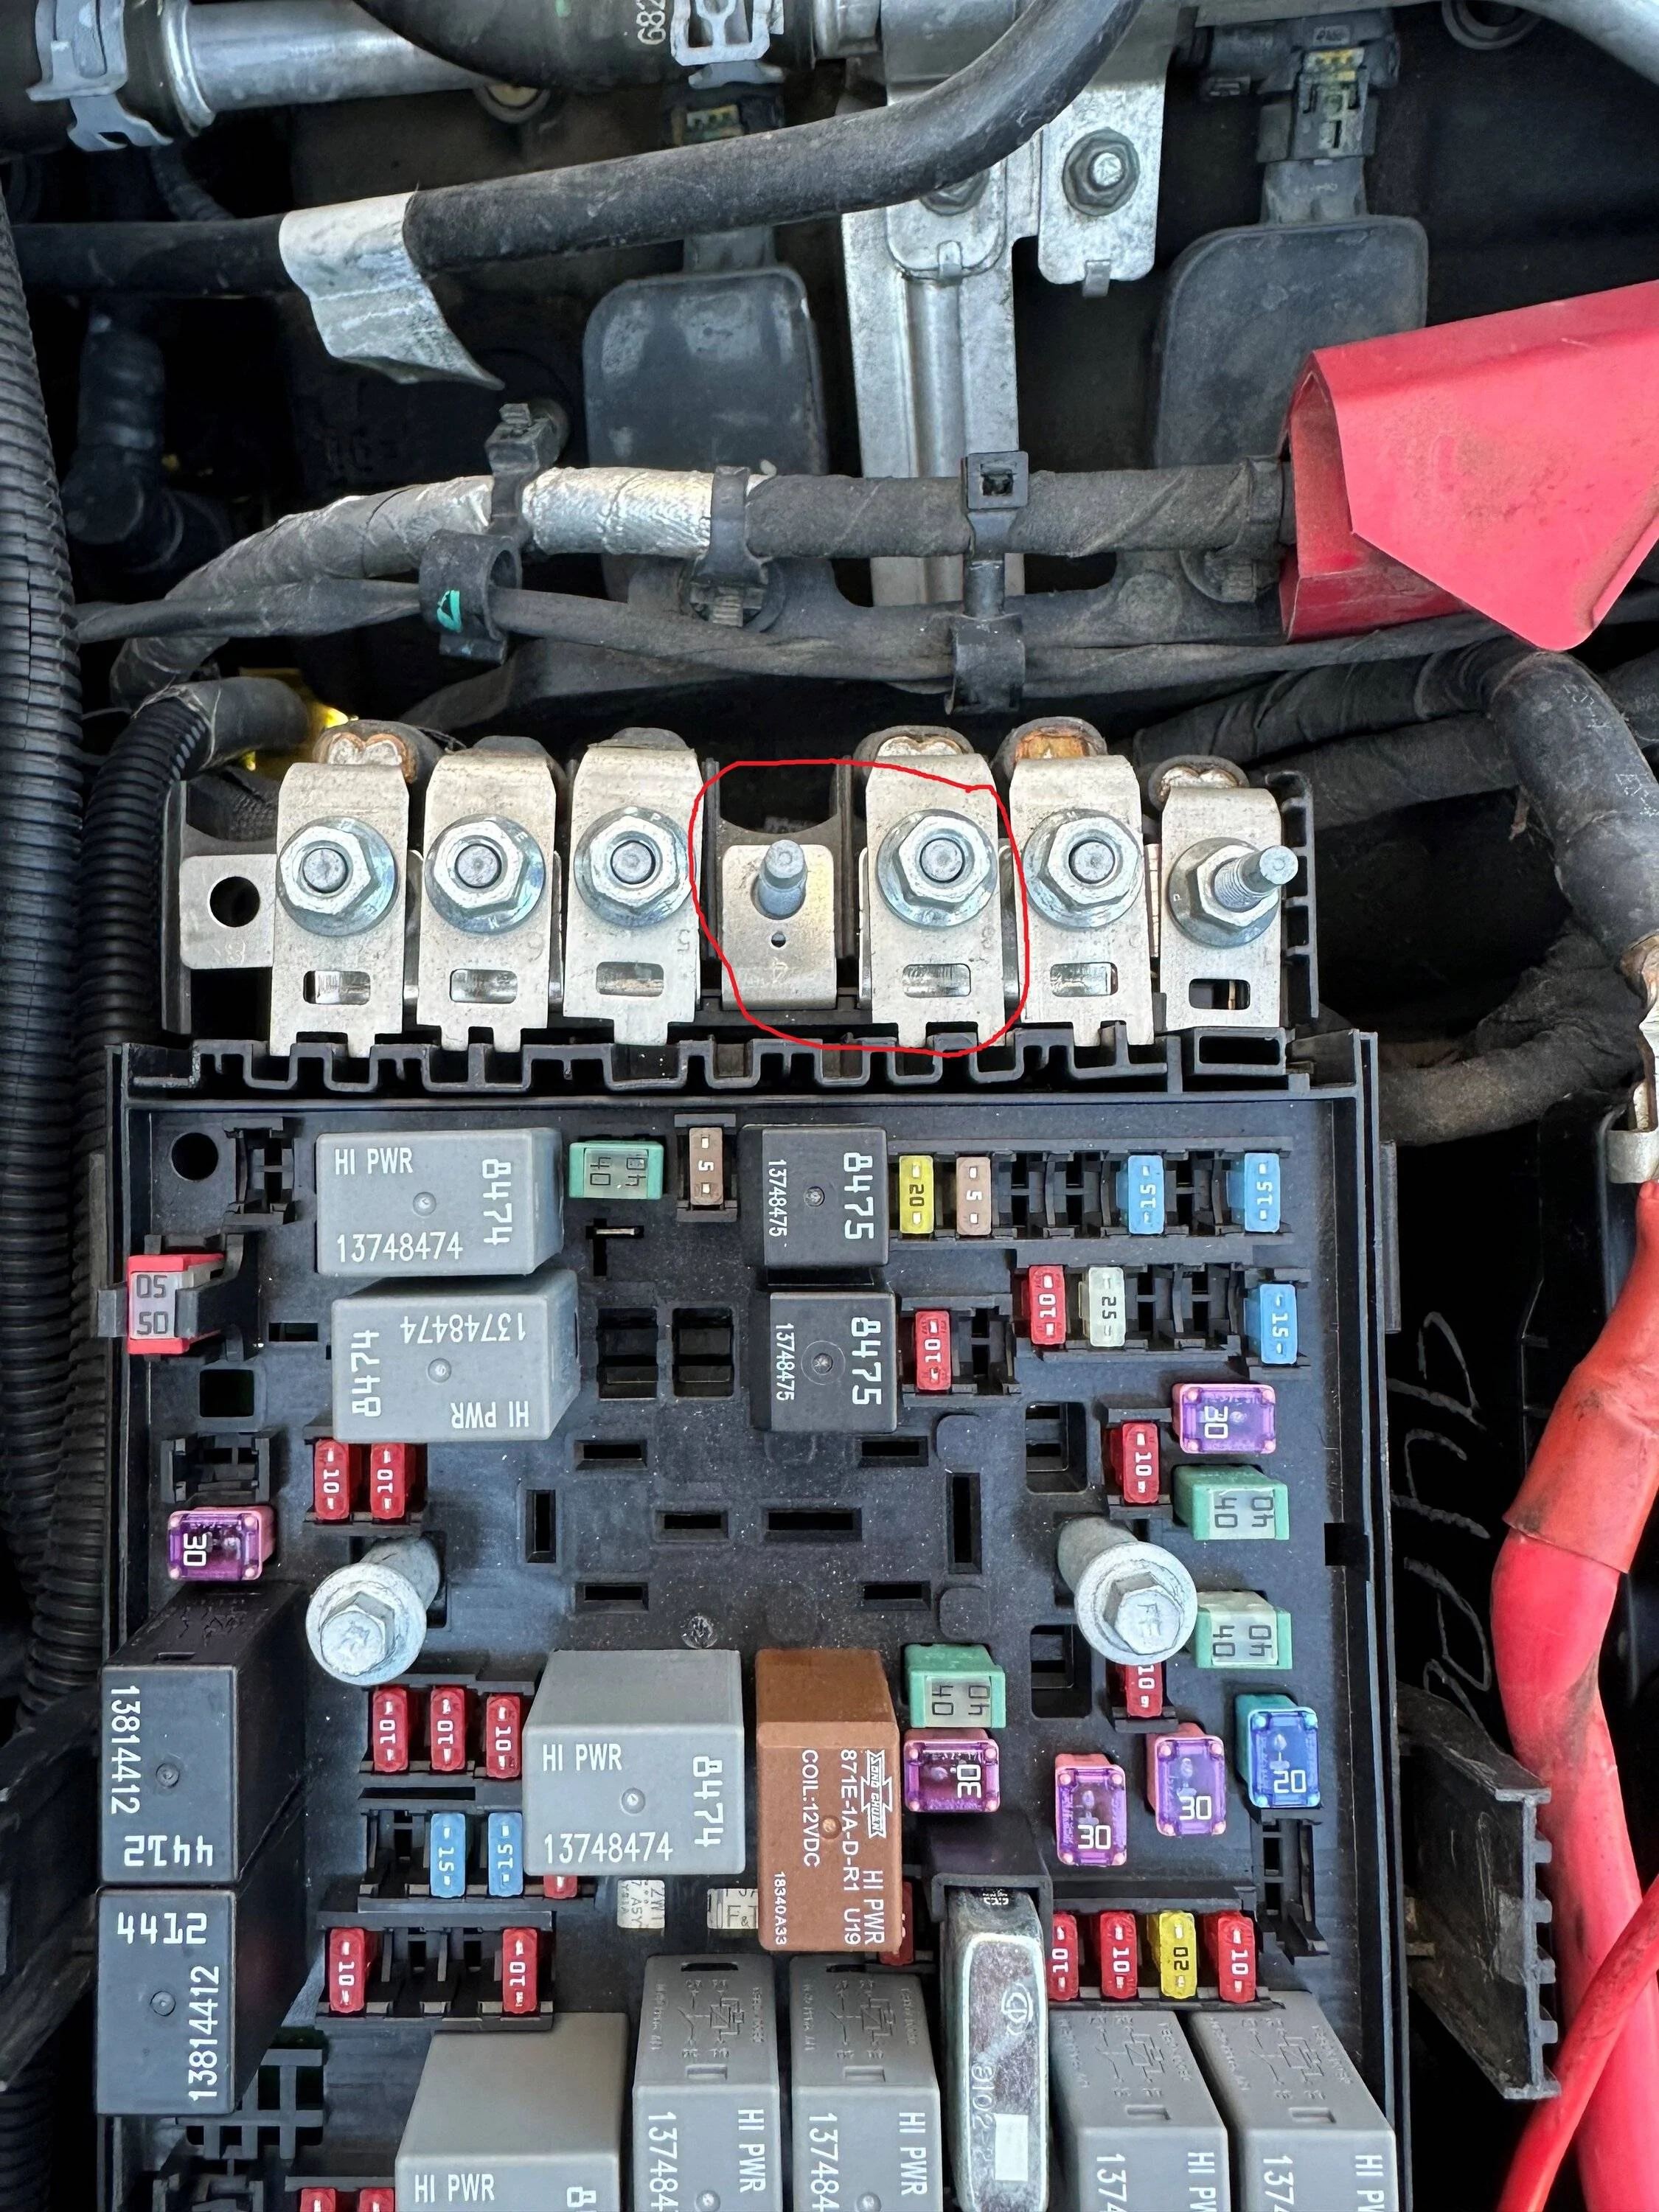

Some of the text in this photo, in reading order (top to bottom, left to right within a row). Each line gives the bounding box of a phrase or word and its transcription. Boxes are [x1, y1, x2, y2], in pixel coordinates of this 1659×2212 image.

[335, 1147, 414, 1175] HI PWR
[590, 1156, 611, 1186] 40
[698, 1160, 714, 1171] 5
[481, 1158, 512, 1246] 8474
[768, 1159, 787, 1237] 13748475
[843, 1152, 874, 1239] 8475
[909, 1184, 925, 1208] 20
[969, 1190, 983, 1201] 5
[1140, 1183, 1157, 1208] 15
[1256, 1181, 1273, 1206] 15
[336, 1231, 464, 1263] 13748474
[1038, 1293, 1057, 1318] 10
[1102, 1296, 1117, 1319] 25
[137, 1311, 168, 1335] 50
[400, 1312, 526, 1344] 13748474
[1272, 1312, 1289, 1338] 15
[775, 1323, 796, 1401] 13748475
[851, 1317, 882, 1405] 8475
[924, 1338, 942, 1363] 10
[350, 1329, 381, 1417] 8474
[450, 1400, 529, 1429] HI PWR
[1203, 1405, 1228, 1439] 30
[1135, 1452, 1152, 1476] 10
[323, 1469, 340, 1494] 10
[377, 1469, 394, 1494] 10
[1214, 1497, 1238, 1528] 40
[1251, 1496, 1274, 1528] 40
[183, 1532, 207, 1567] 30
[1212, 1625, 1236, 1657] 40
[1248, 1624, 1273, 1657] 40
[1137, 1664, 1155, 1689] 10
[932, 1685, 954, 1716] 40
[967, 1686, 990, 1715] 40
[379, 1719, 396, 1745] 10
[437, 1720, 454, 1745] 10
[495, 1726, 512, 1751] 10
[111, 1685, 142, 1815] 13814412
[543, 1743, 622, 1772] HI PWR
[956, 1764, 982, 1799] 30
[1273, 1769, 1307, 1794] 20
[692, 1756, 724, 1848] 8474
[801, 1749, 821, 1868] COIL:12VDC
[1178, 1795, 1212, 1820] 30
[544, 1832, 673, 1864] 13748474
[840, 1749, 861, 1945] 871E-1A-D-R1 U19
[1077, 1824, 1111, 1850] 30
[438, 1847, 455, 1872] 15
[497, 1843, 513, 1869] 15
[773, 1871, 787, 1945] 18340A33
[862, 1870, 885, 1945] HI PWR
[1051, 1948, 1069, 1973] 10
[1112, 1947, 1130, 1972] 10
[1173, 1947, 1189, 1971] 20
[1231, 1950, 1249, 1975] 10
[338, 1961, 355, 1986] 10
[509, 1961, 526, 1986] 10
[188, 1966, 219, 2101] 13814412
[737, 2109, 766, 2193] HI PWR
[899, 2112, 928, 2196] HI PWR
[1187, 2152, 1216, 2174] HI
[1354, 2154, 1384, 2177] HI
[414, 2173, 495, 2203] HI PWR
